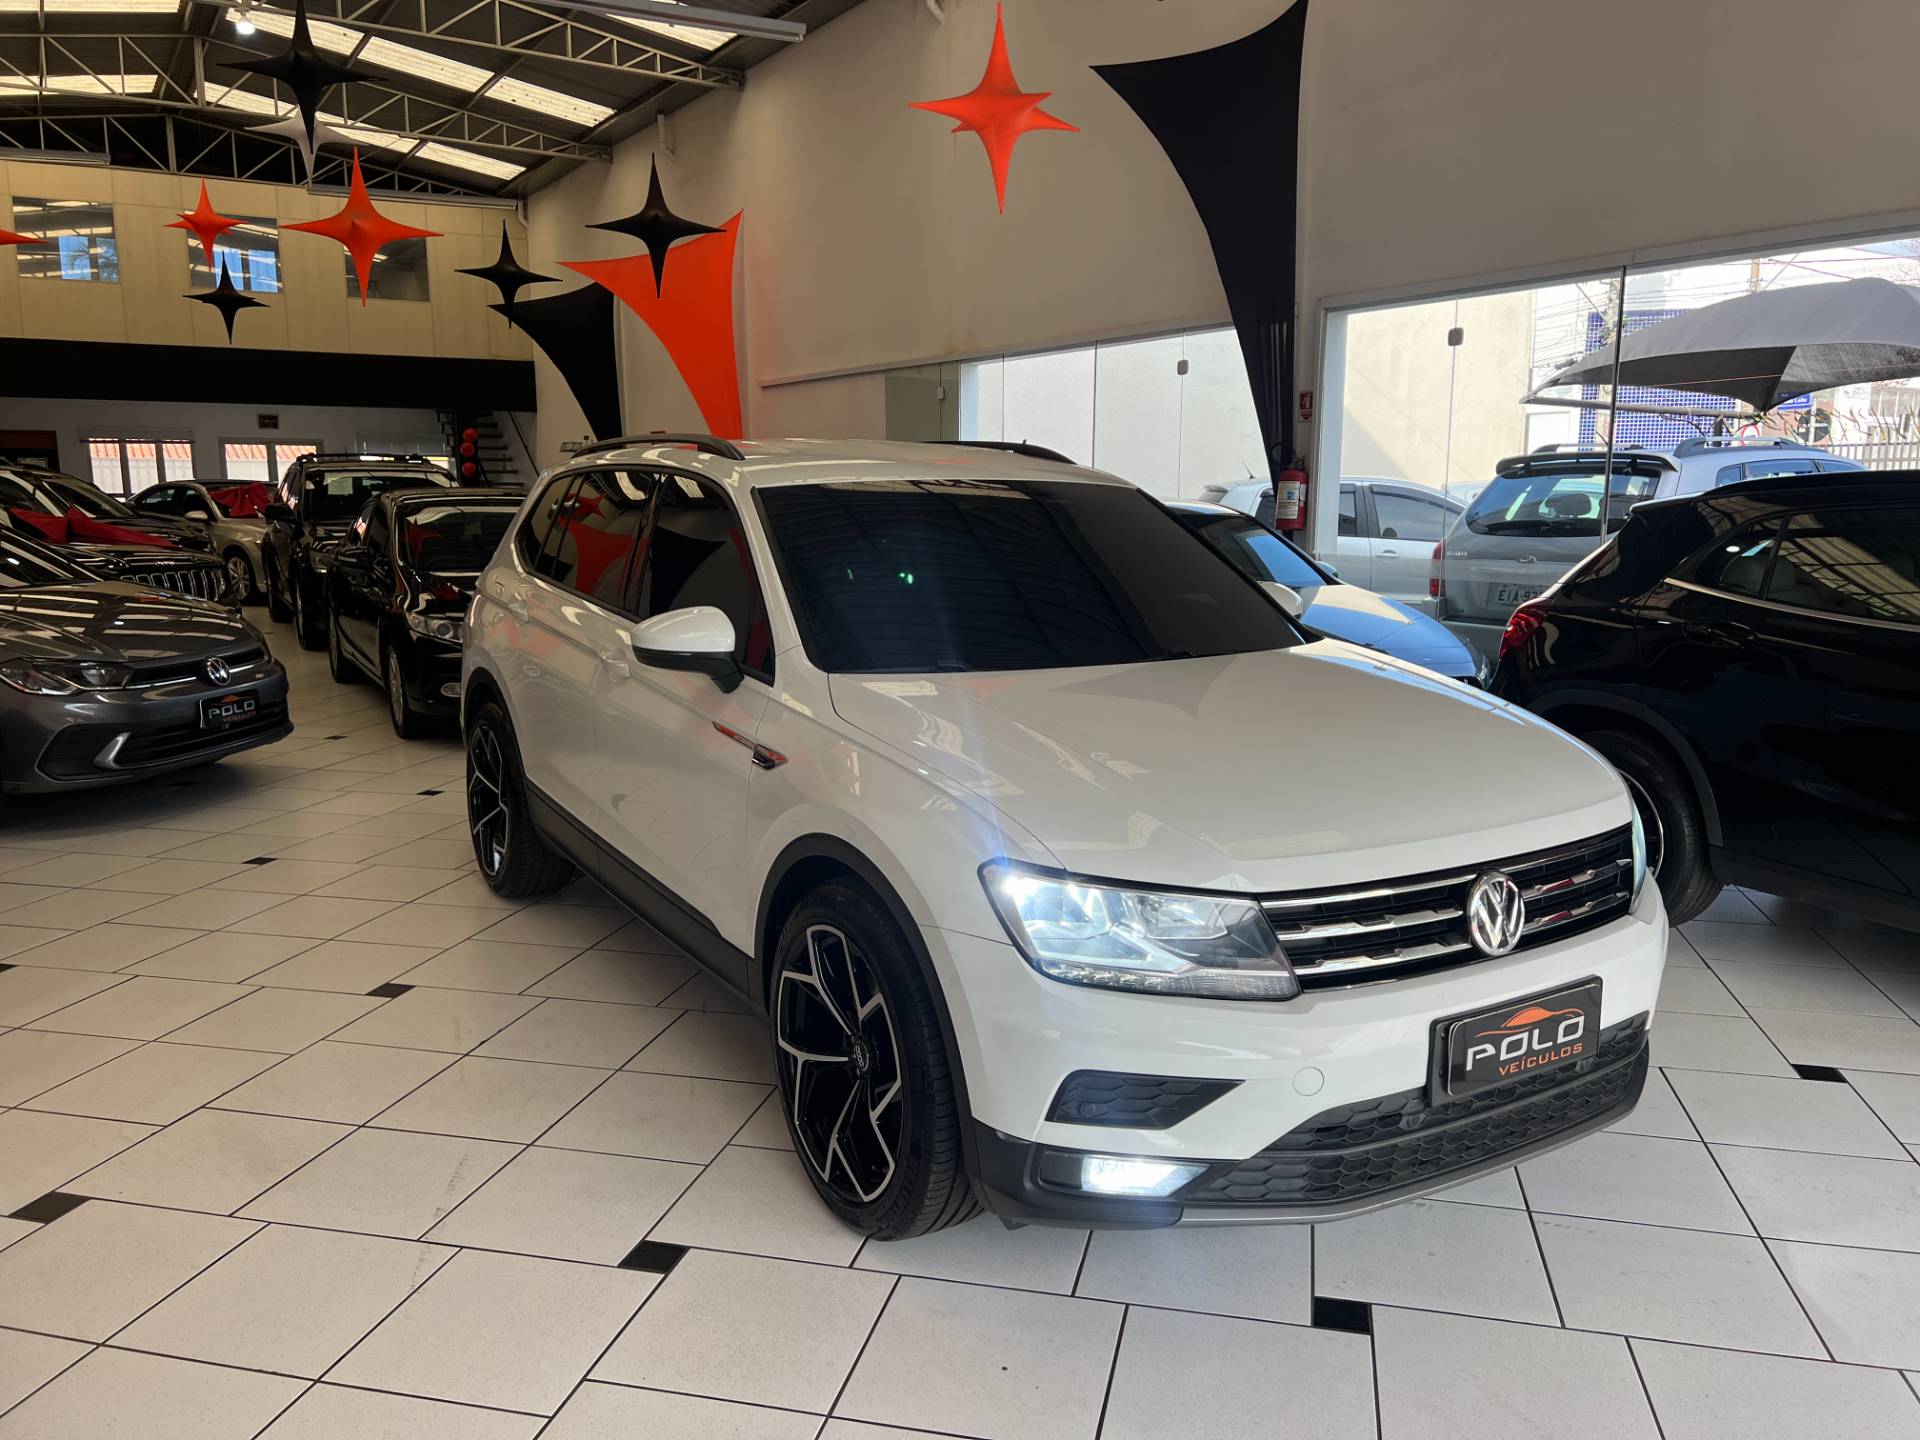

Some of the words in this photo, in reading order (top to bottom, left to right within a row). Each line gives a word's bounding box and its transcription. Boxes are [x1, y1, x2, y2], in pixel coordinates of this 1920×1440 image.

[207, 699, 256, 719] POLO
[1466, 1015, 1585, 1071] POLO
[1498, 1042, 1584, 1077] VEÍCULOS
